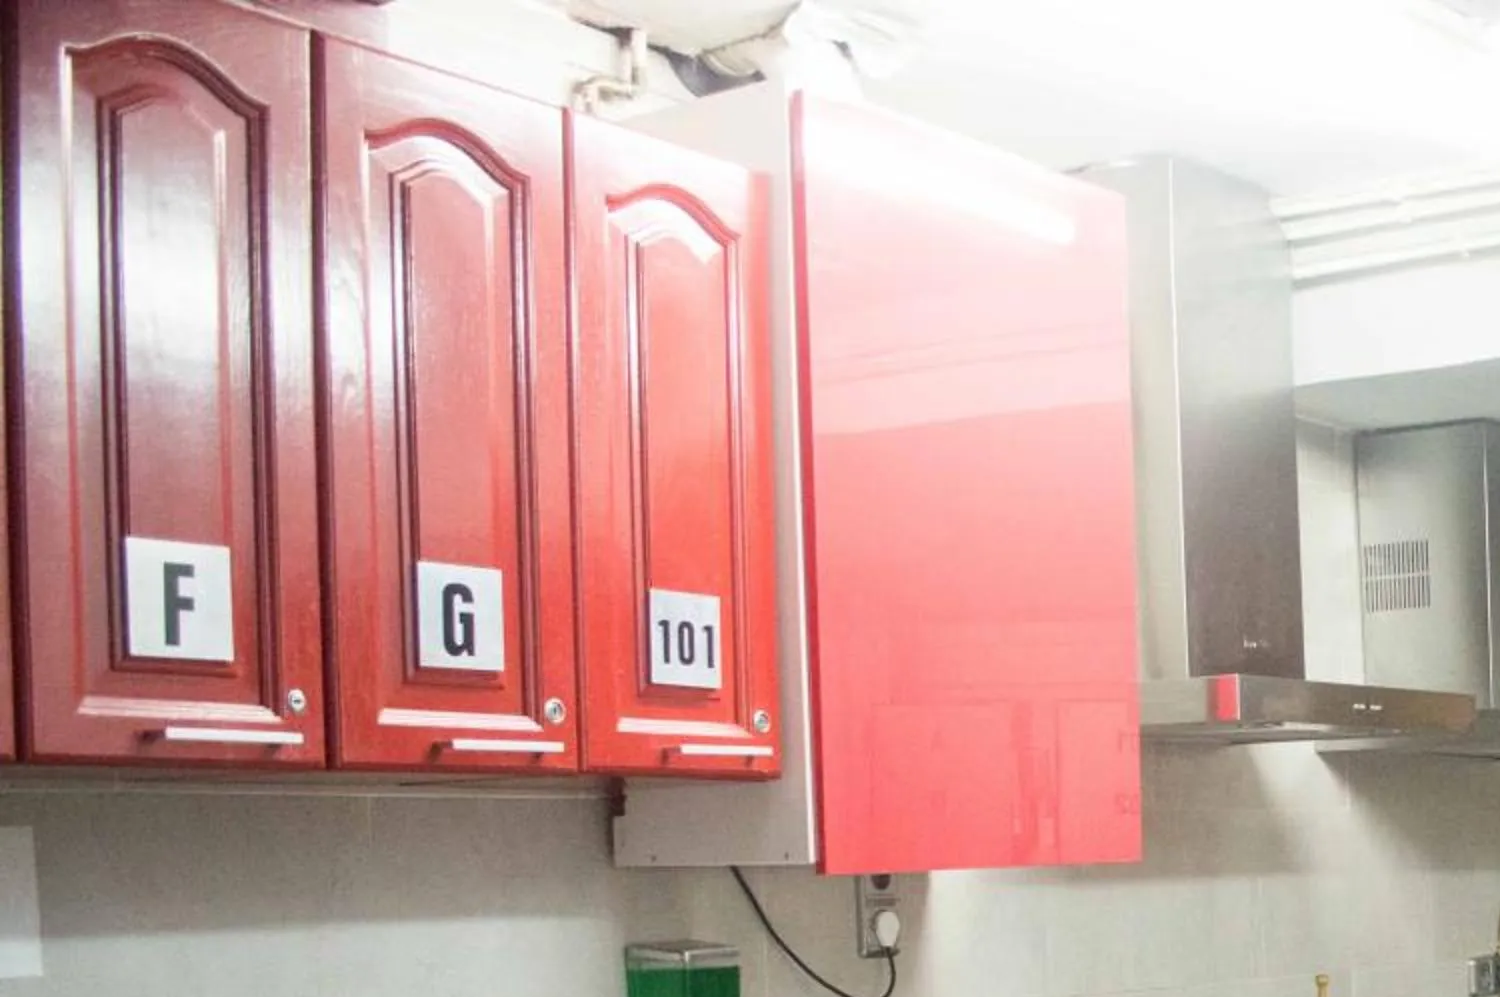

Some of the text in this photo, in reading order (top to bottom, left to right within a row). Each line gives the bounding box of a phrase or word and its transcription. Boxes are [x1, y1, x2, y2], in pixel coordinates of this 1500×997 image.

[163, 562, 195, 647] F
[442, 583, 475, 657] G
[657, 619, 715, 669] 101
